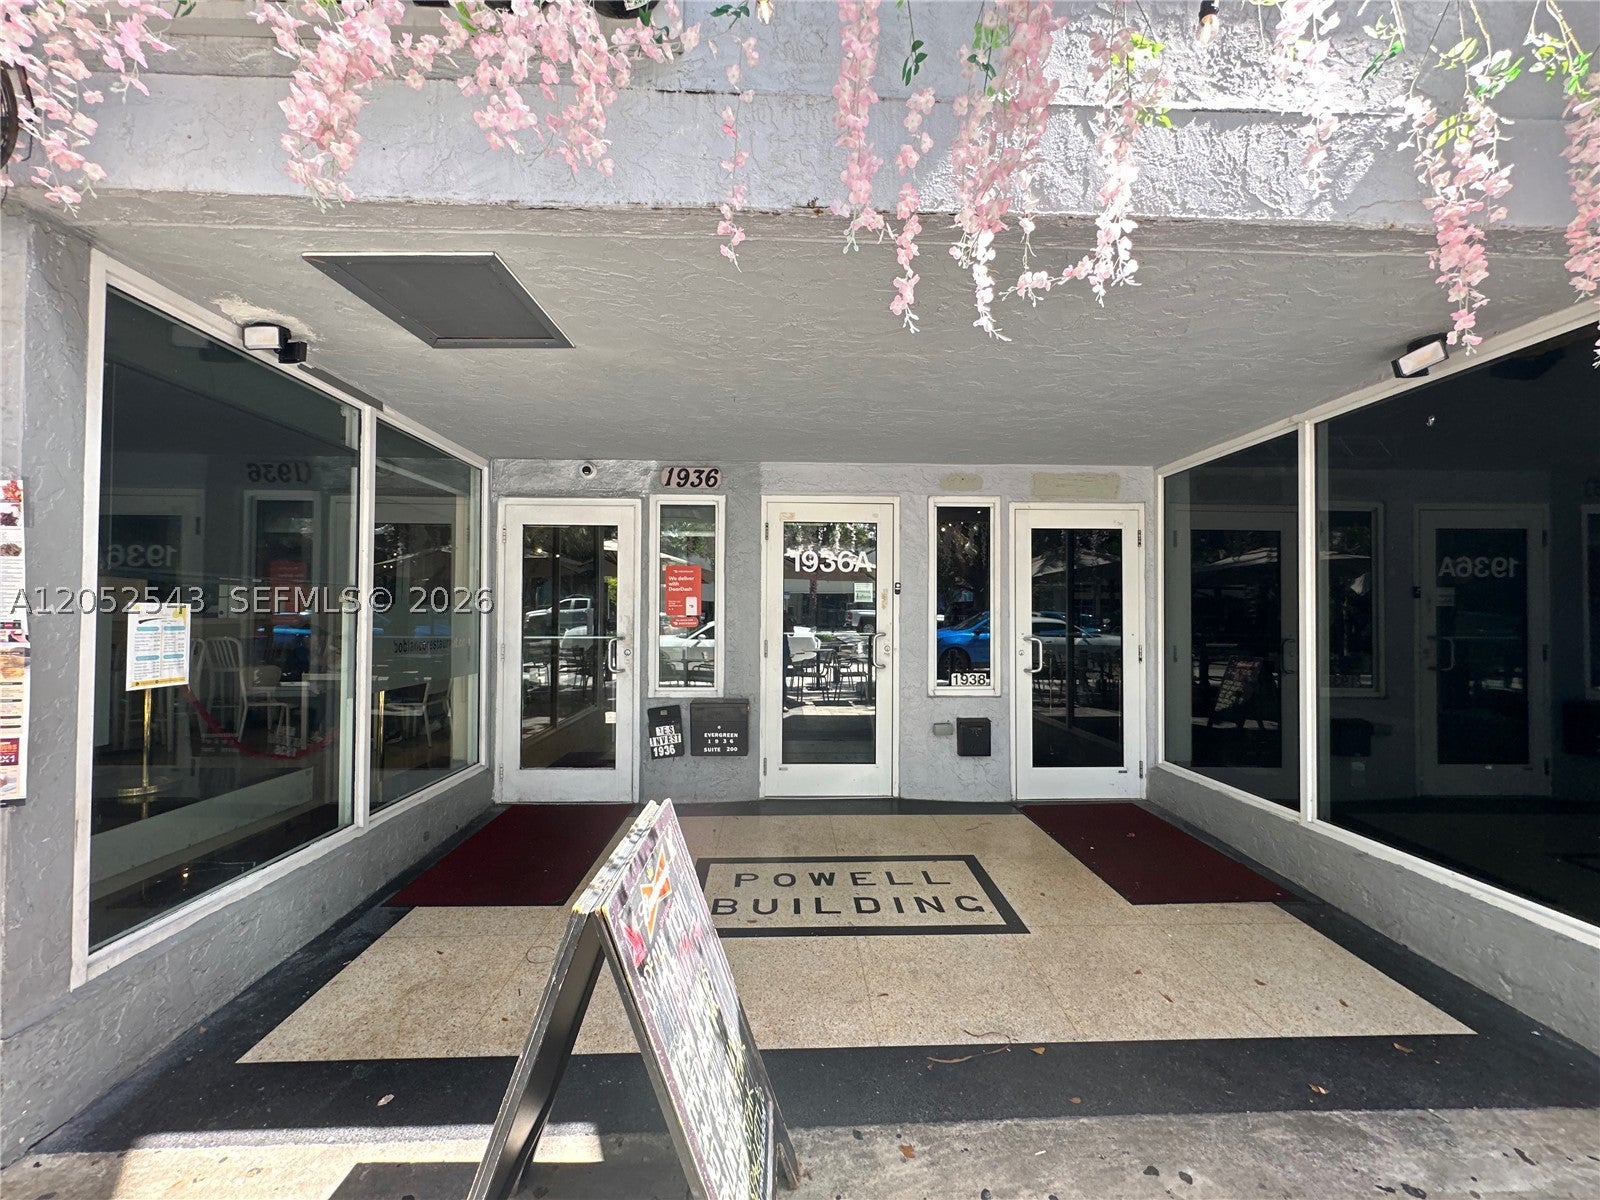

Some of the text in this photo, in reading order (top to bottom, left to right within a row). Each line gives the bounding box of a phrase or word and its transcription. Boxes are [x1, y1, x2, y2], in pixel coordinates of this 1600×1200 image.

[664, 467, 719, 488] 1936
[791, 550, 873, 573] 1936A
[953, 674, 986, 685] 1938
[650, 733, 682, 746] INVEST
[653, 745, 676, 757] 1936
[733, 870, 951, 888] POWELL
[711, 895, 985, 915] BUILDING
